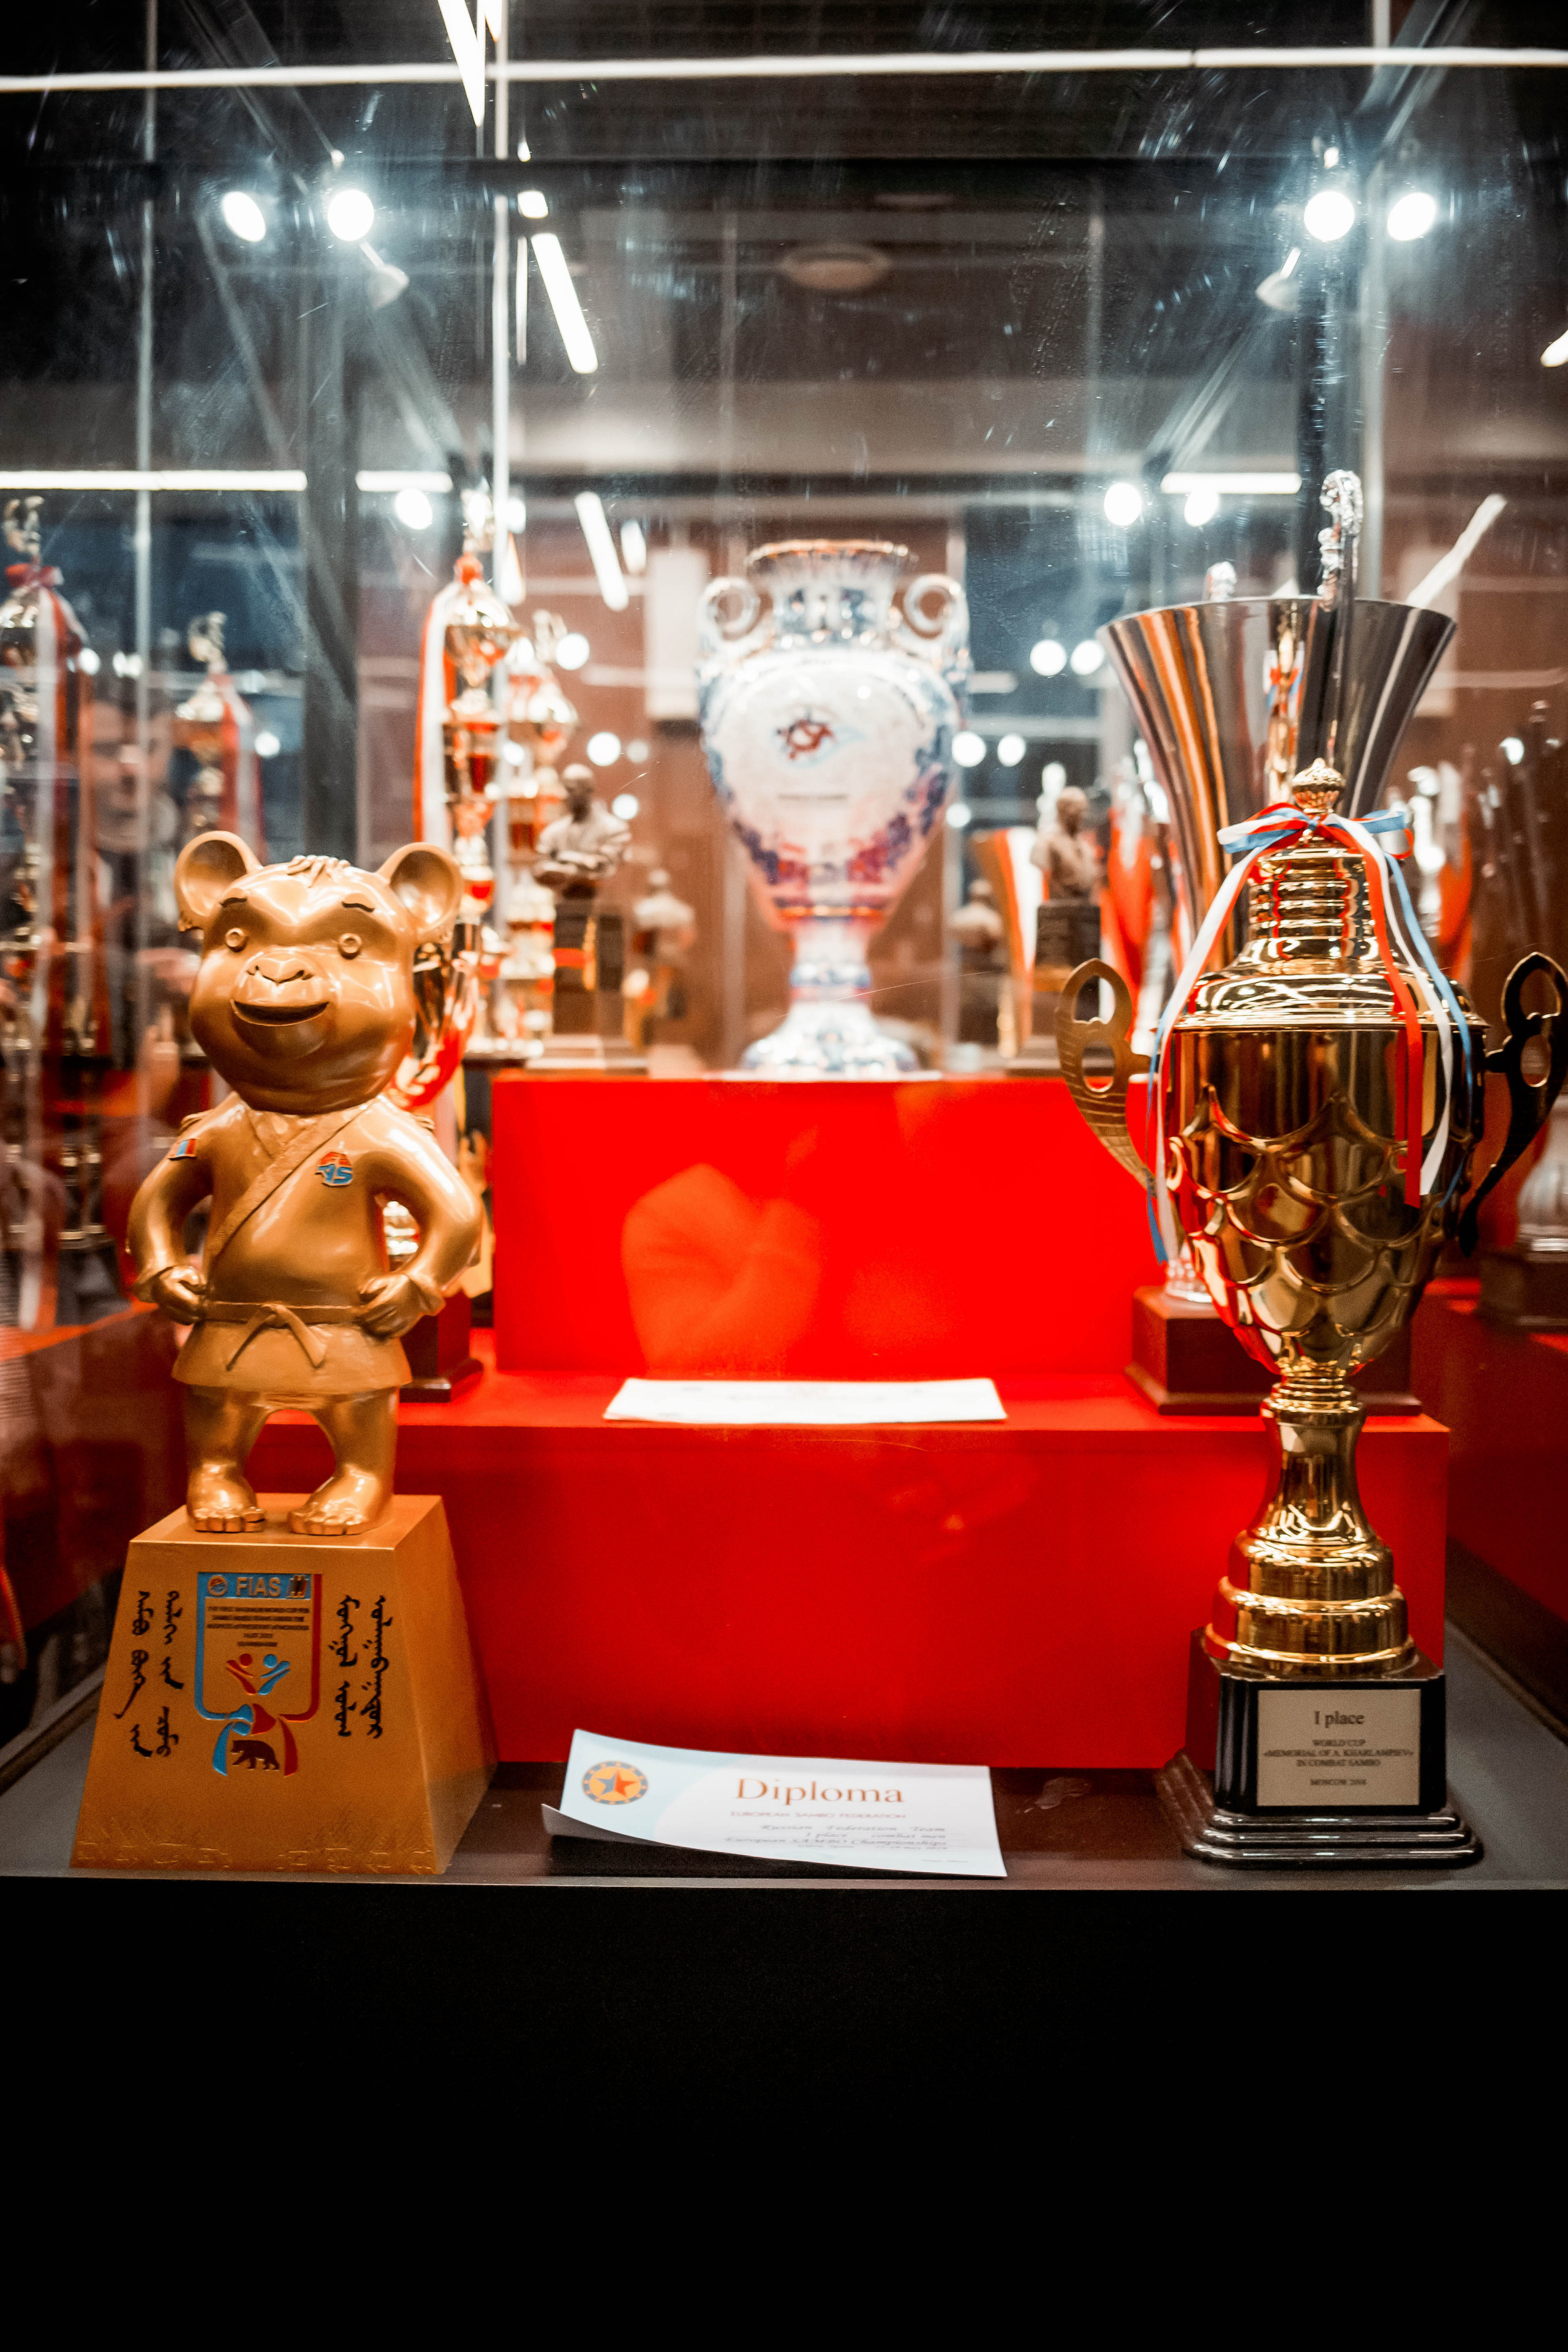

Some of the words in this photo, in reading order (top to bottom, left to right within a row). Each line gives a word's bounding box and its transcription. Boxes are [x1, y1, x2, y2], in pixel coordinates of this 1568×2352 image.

[236, 1577, 281, 1596] FIAS
[1314, 1711, 1321, 1725] I
[1325, 1711, 1365, 1728] place
[735, 1778, 904, 1806] Diploma
